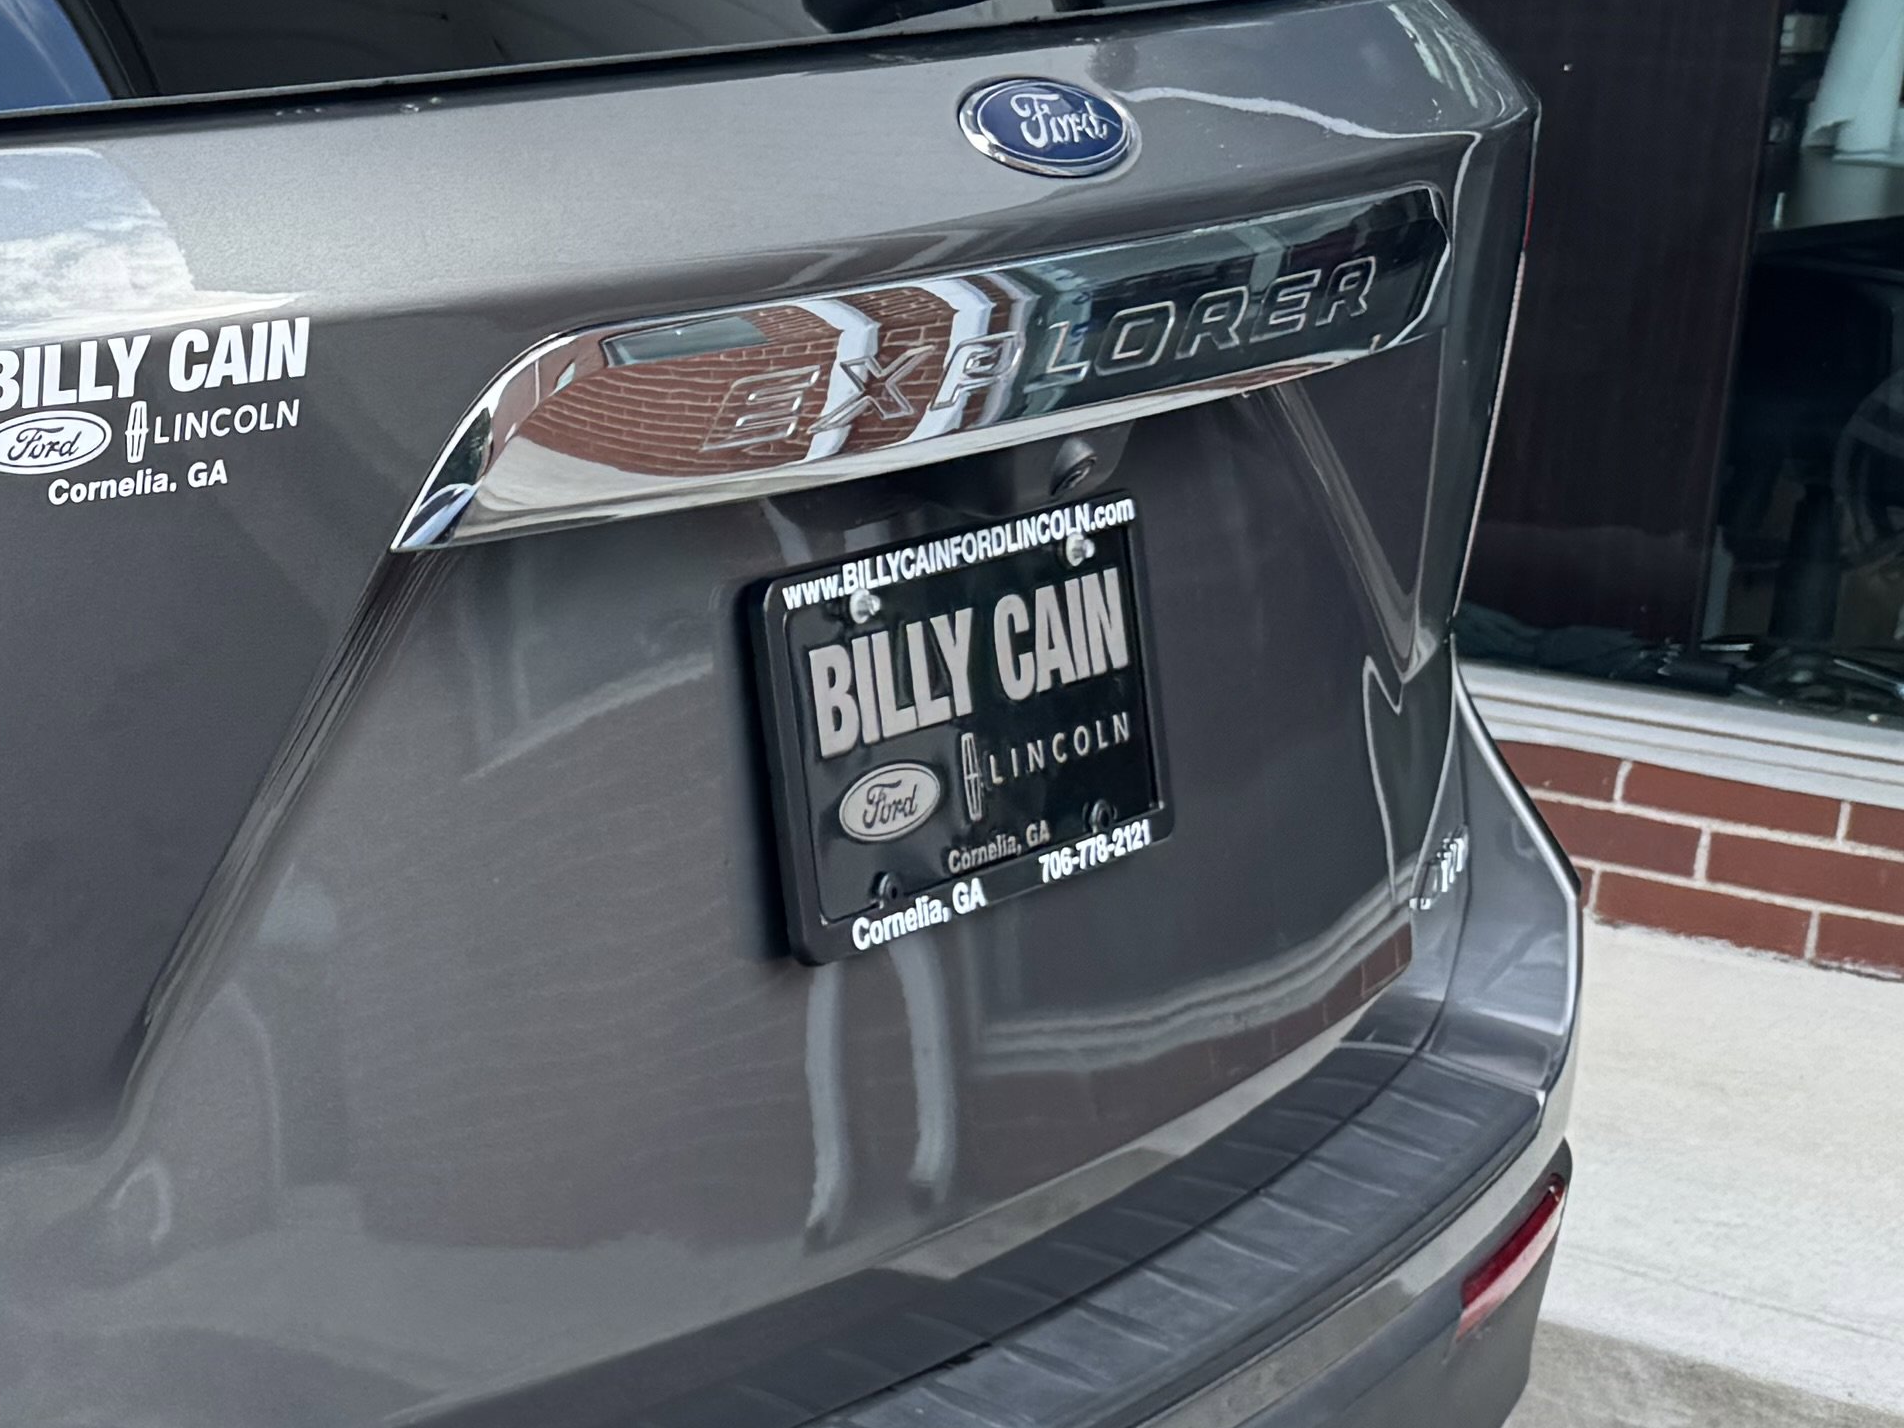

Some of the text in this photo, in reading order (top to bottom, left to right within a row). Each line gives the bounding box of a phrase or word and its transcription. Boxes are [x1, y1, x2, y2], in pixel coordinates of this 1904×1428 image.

[1011, 95, 1110, 148] Ford
[168, 317, 310, 392] CAIN
[701, 256, 1376, 453] EXPLORER
[7, 399, 300, 462] Ford LINCOLN
[187, 459, 228, 488] GA
[809, 567, 1130, 759] BILLY CAIN
[989, 711, 1131, 785] LINCOLN
[861, 781, 919, 828] Ford
[948, 822, 1051, 874] Cornelia, GA
[1039, 818, 1152, 883] 706-778-2121
[852, 877, 987, 950] Cornelia, GA
